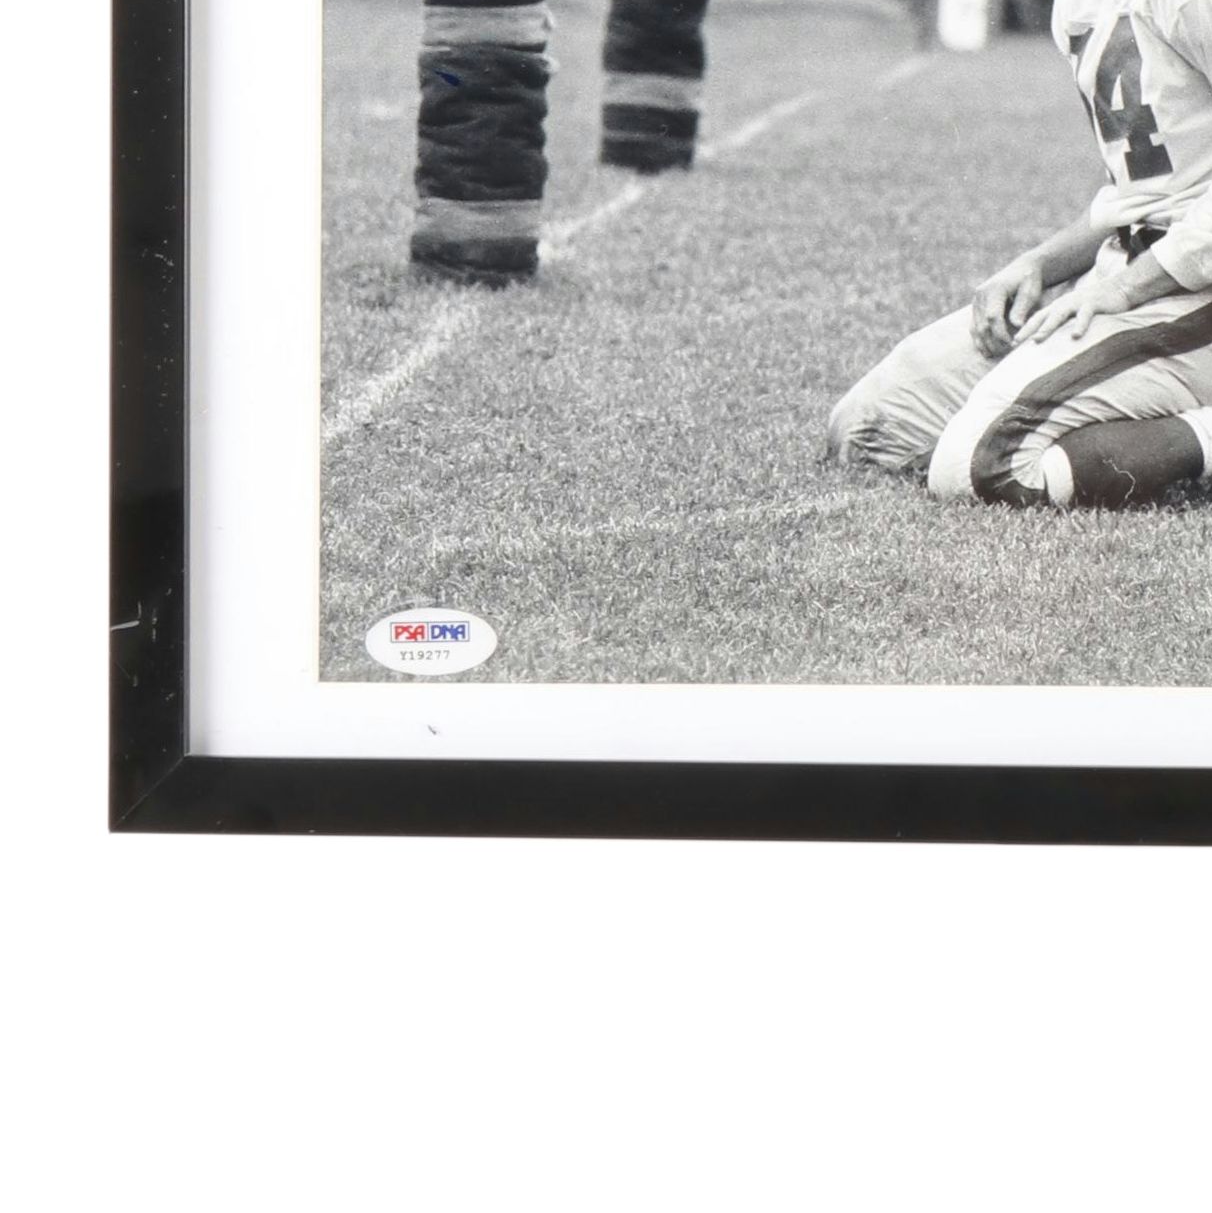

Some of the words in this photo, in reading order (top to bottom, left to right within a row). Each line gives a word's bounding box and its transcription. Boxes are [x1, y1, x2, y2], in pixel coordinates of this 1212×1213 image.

[394, 624, 426, 642] PSA
[430, 624, 466, 640] DNA
[400, 649, 450, 661] Y19277
